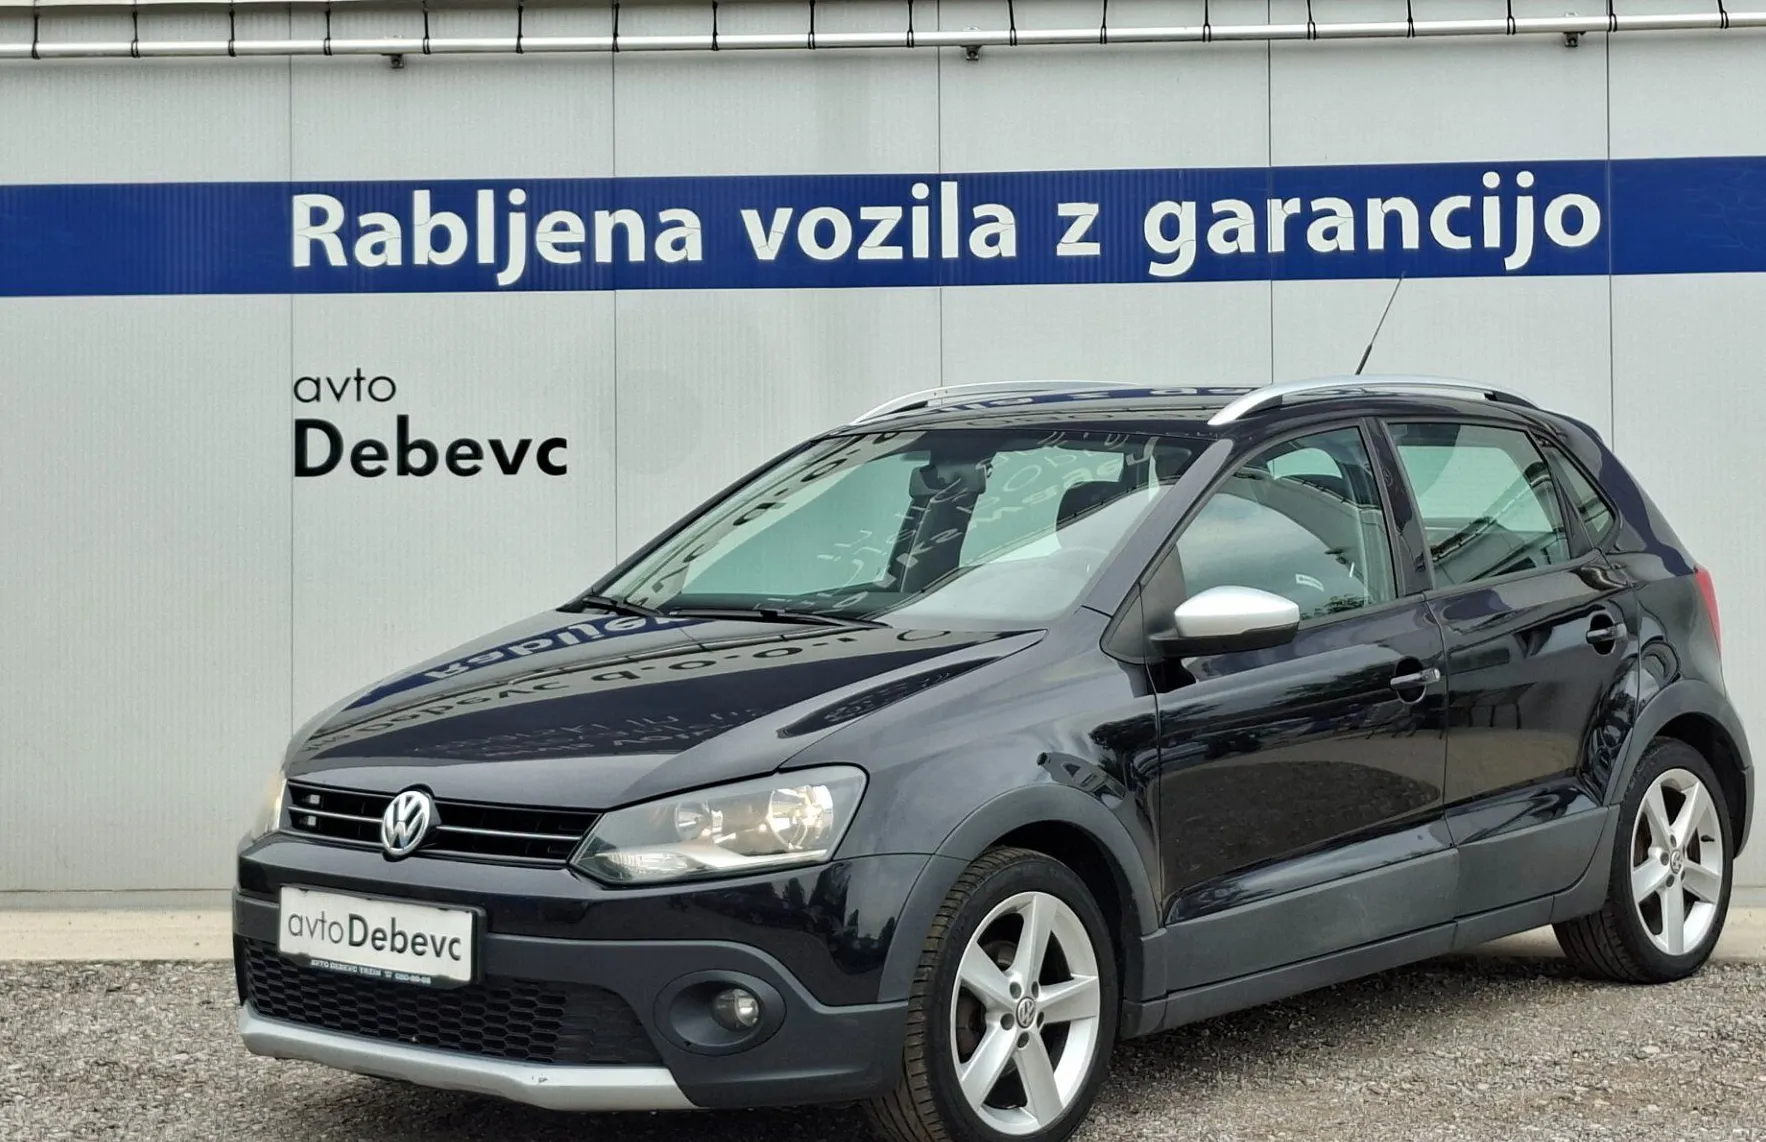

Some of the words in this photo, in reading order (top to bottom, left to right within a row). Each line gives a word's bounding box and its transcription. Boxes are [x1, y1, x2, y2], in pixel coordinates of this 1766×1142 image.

[292, 188, 703, 286] Rabljena
[740, 181, 1017, 261] vozila
[1056, 202, 1101, 256] z
[1144, 171, 1601, 277] garancijo
[293, 367, 397, 403] avto
[295, 415, 568, 478] Debevc
